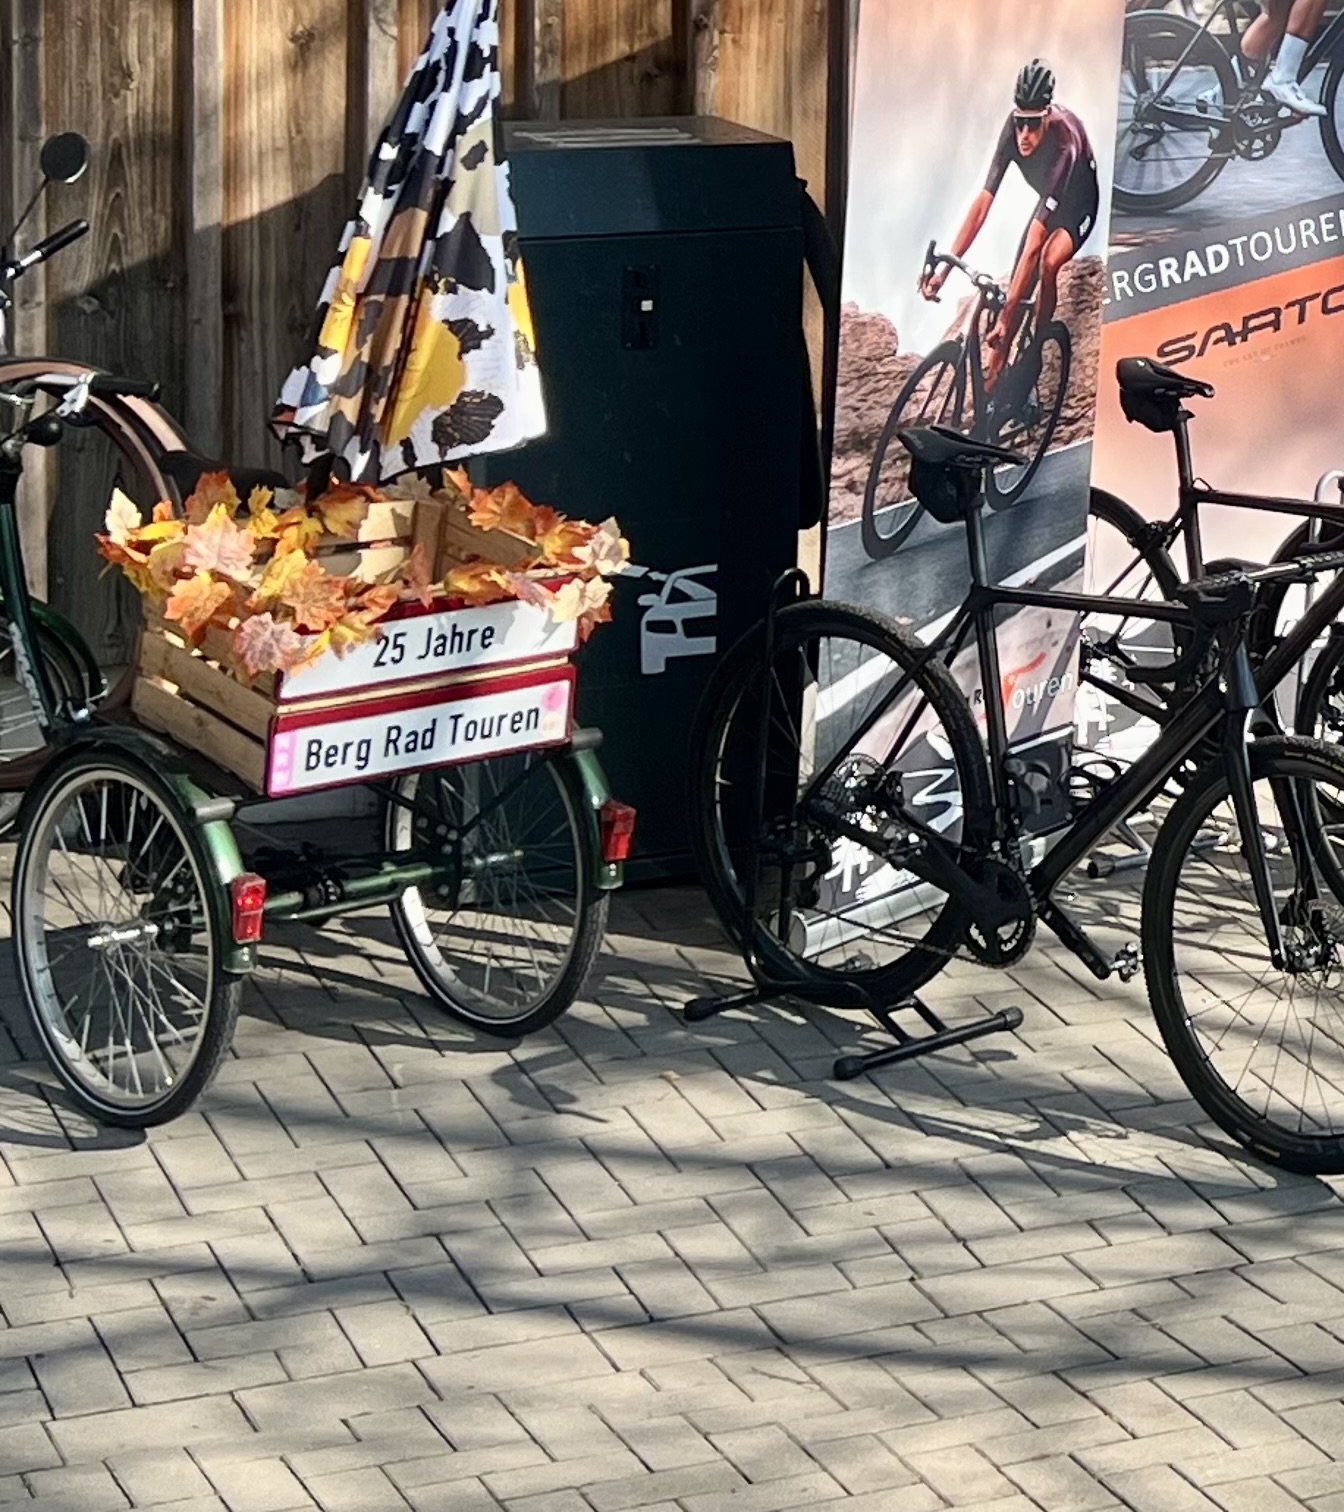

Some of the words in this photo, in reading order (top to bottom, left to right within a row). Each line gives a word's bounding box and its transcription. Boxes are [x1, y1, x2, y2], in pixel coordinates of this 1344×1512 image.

[373, 631, 405, 668] 25
[417, 622, 496, 662] Jahre
[304, 738, 371, 773] Berg
[383, 717, 437, 758] Rad
[450, 705, 540, 746] Touren
